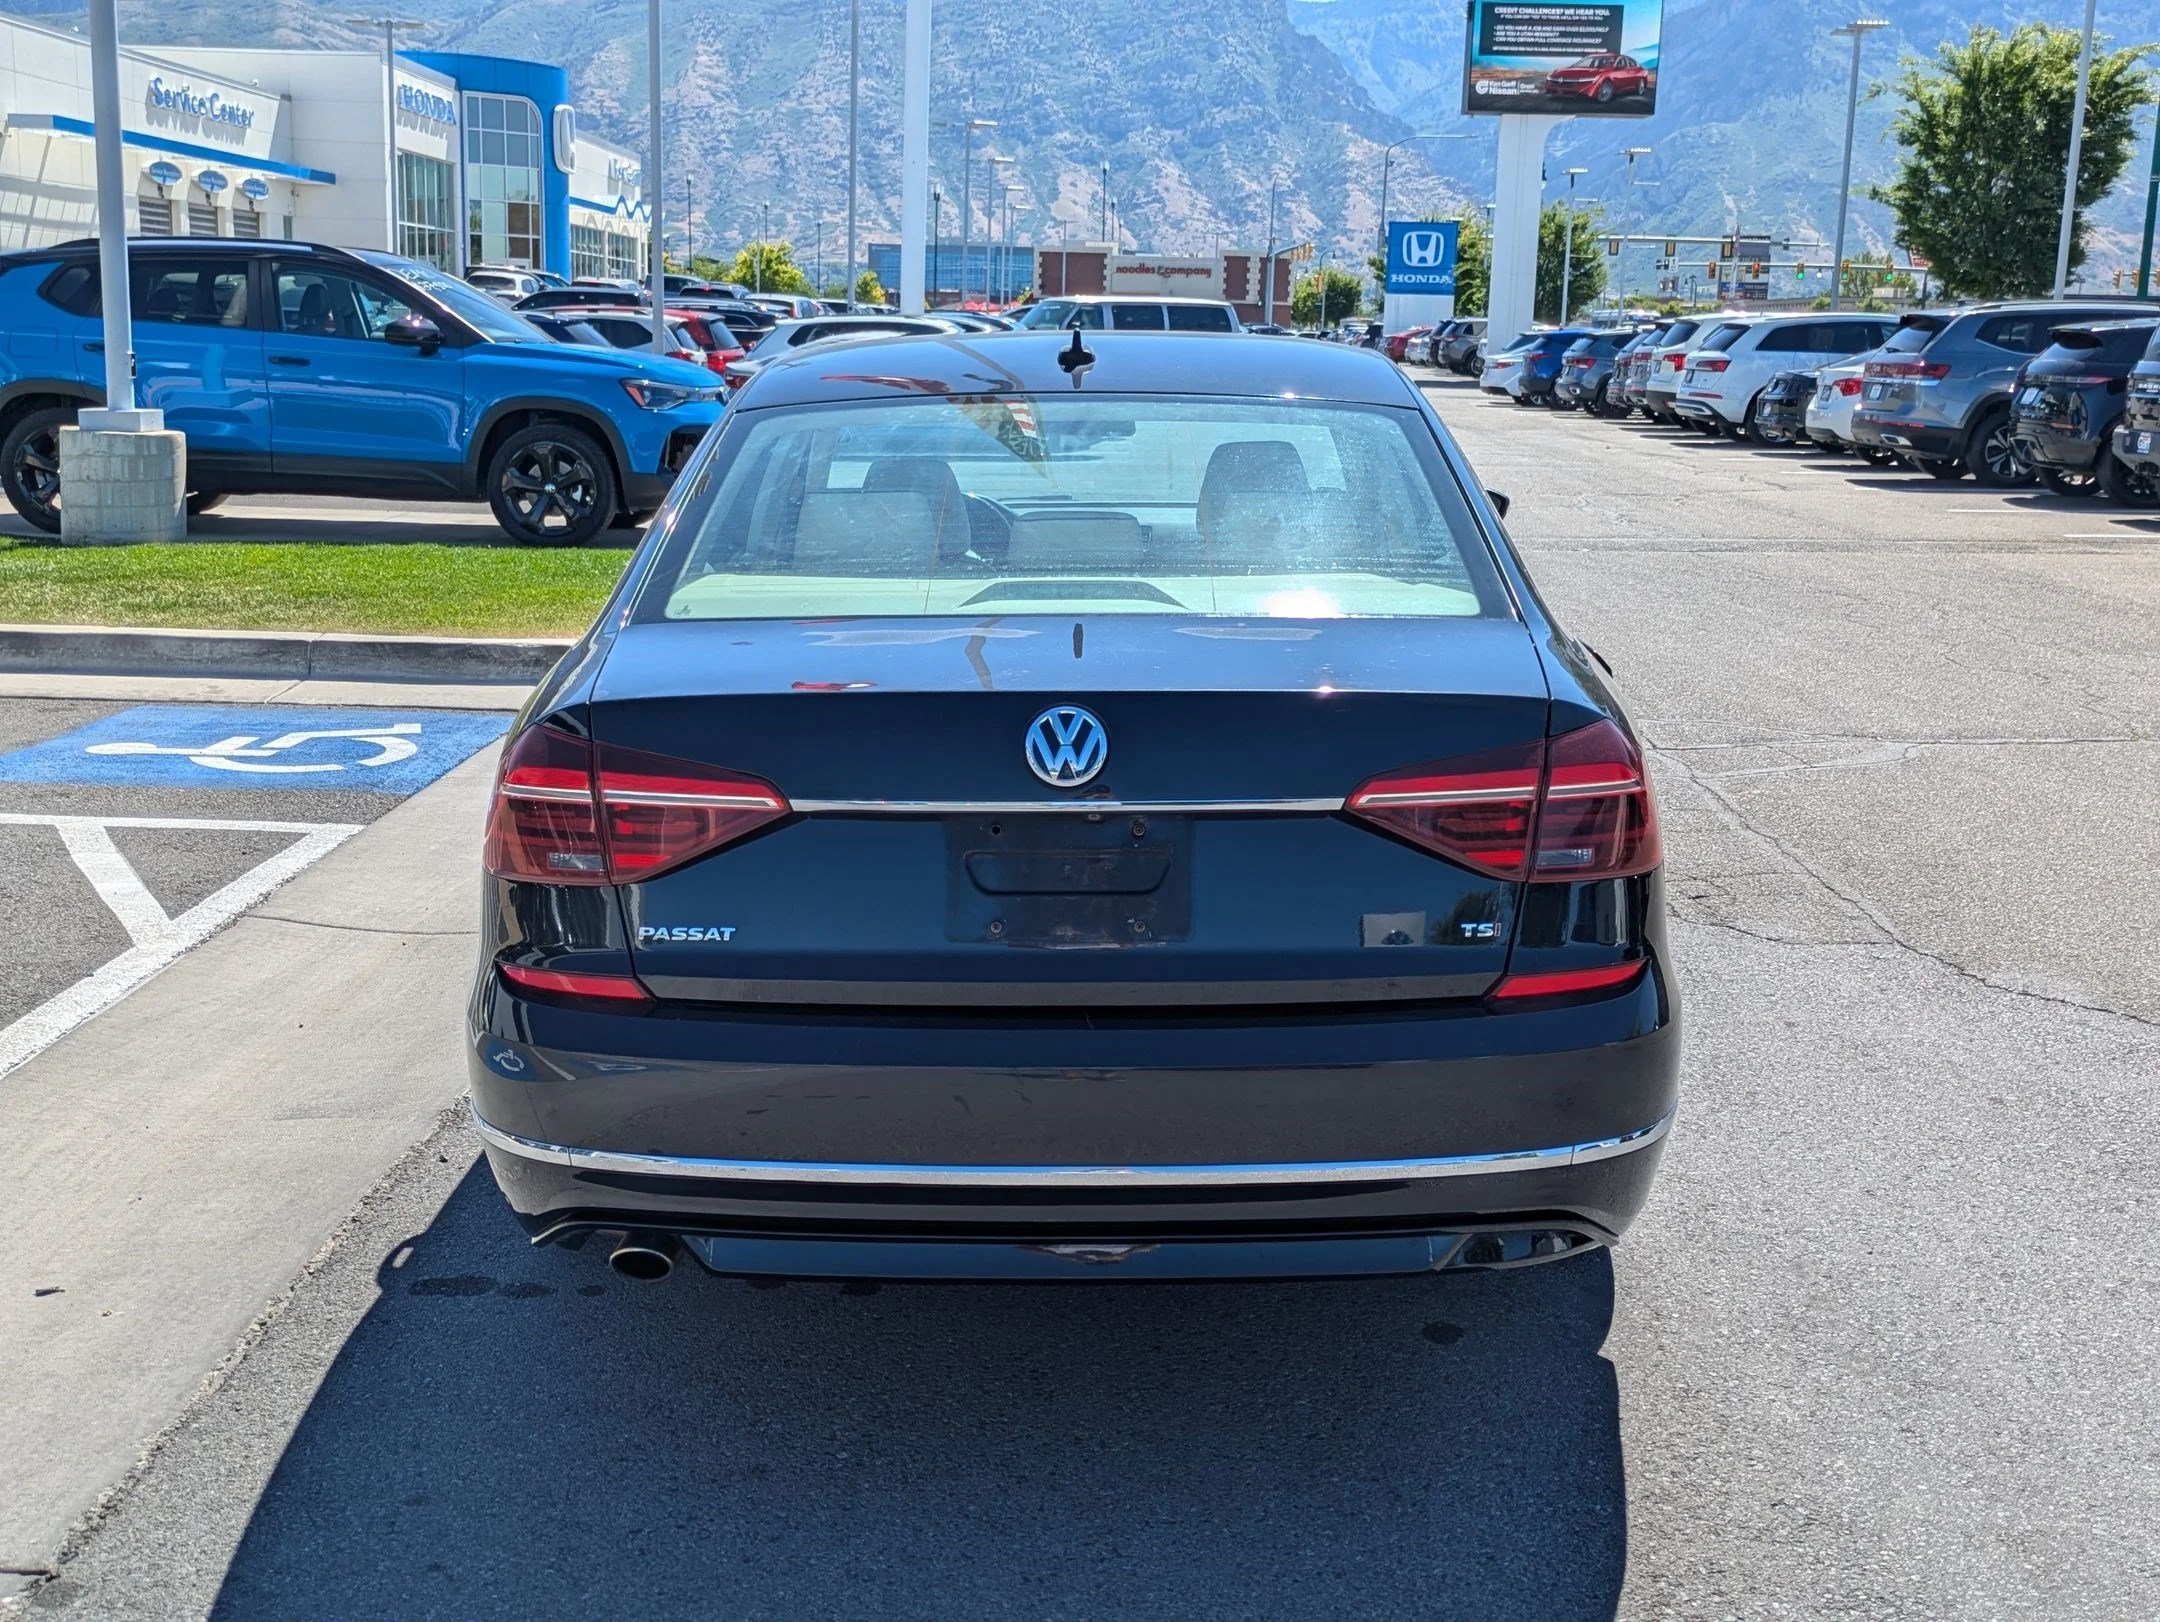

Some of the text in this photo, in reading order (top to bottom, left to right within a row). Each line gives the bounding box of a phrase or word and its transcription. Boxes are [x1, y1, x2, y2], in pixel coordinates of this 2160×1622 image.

[1575, 8, 1594, 16] HEAR
[1489, 87, 1517, 95] Nissan
[153, 77, 254, 128] Service Center
[399, 84, 457, 125] HONDA
[1116, 262, 1156, 274] noodles
[1164, 267, 1212, 279] company
[1391, 274, 1452, 284] HONDA
[638, 926, 736, 941] PASSAT
